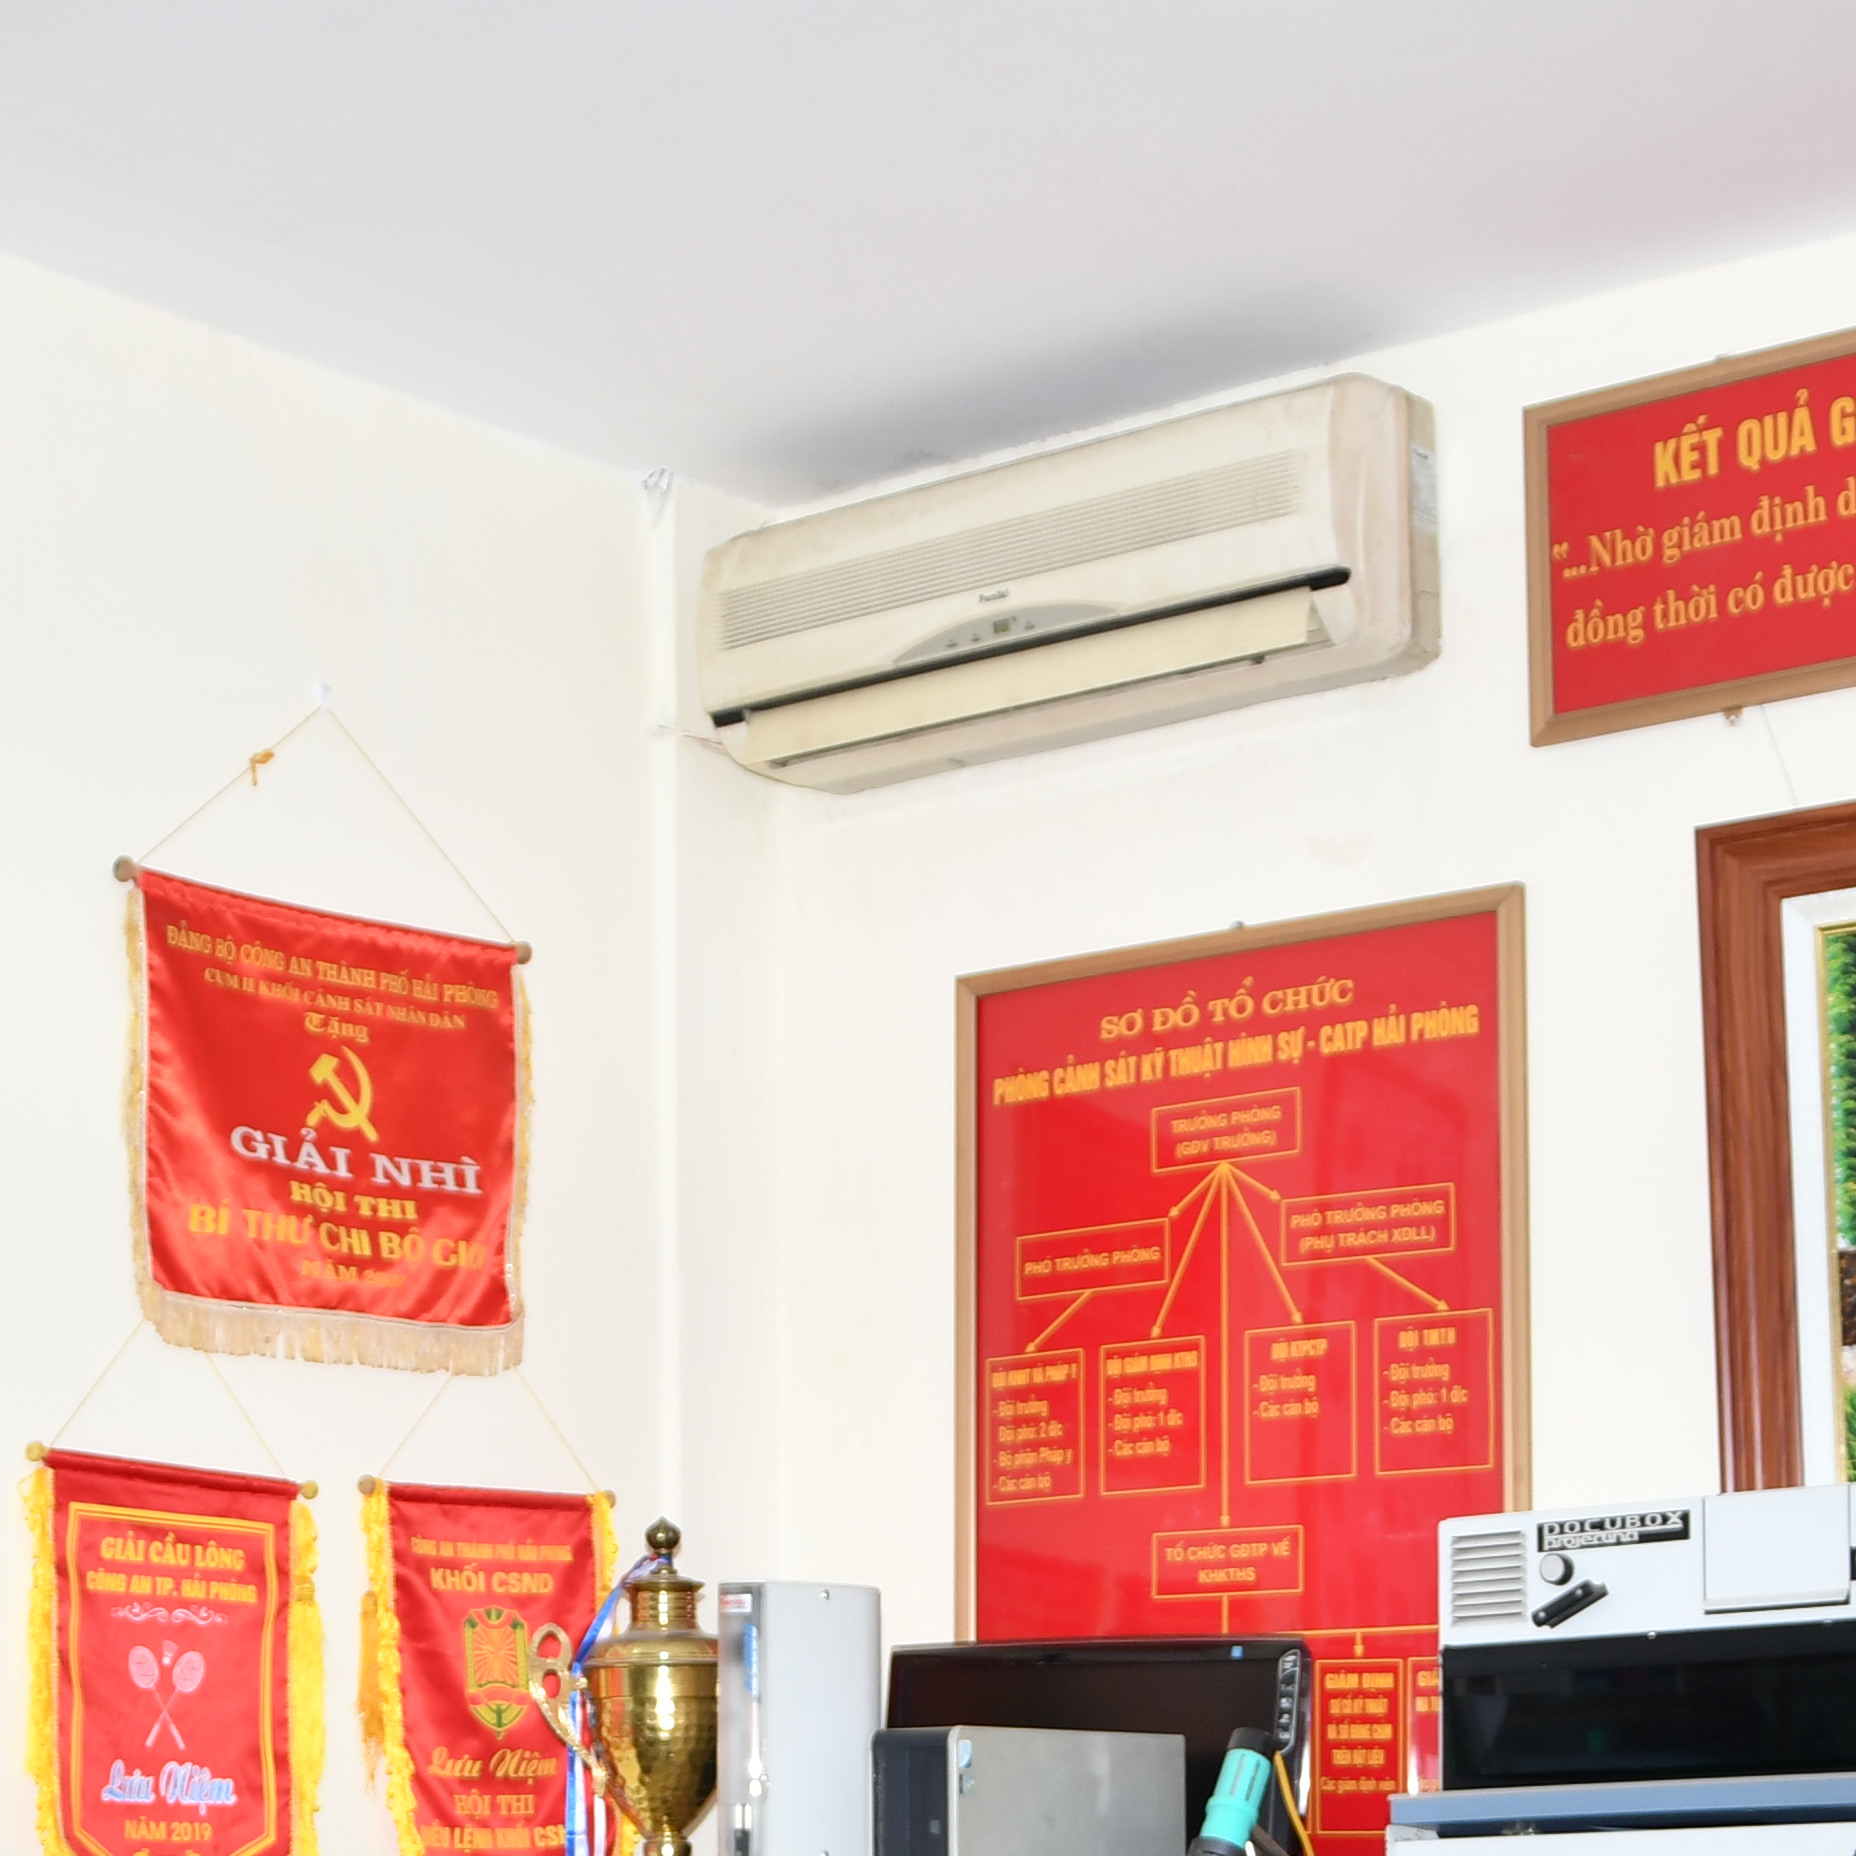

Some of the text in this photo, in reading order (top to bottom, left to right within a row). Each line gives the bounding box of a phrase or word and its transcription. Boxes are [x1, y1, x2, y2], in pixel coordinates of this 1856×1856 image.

[1655, 415, 1722, 488] KẾT
[1738, 389, 1816, 470] QUẢ
[1663, 512, 1742, 563] giám
[1752, 486, 1827, 541] định
[1568, 600, 1644, 647] đồng
[1654, 585, 1717, 629] thời
[1728, 572, 1764, 613] có
[1774, 562, 1853, 605] được
[1100, 977, 1355, 1040] SƠ ĐỒ TỔ CHỨC
[992, 1001, 1480, 1105] PHÒNG CẢNH SÁT KỸ THUẬT HÌNH SỰ CATP HẢI PHÒNG
[230, 1125, 483, 1194] GIẢI NHÌ
[189, 1198, 425, 1264] BÍ THƯ CHI BỘ
[290, 1180, 418, 1220] HỘI THI
[101, 1531, 245, 1570] GIẢI CẦU LÔNG
[1544, 1511, 1683, 1535] DOCUBOX
[430, 1562, 553, 1594] KHỐI CSND
[124, 1817, 213, 1841] NĂM 2019
[454, 1789, 534, 1819] HỘI THI
